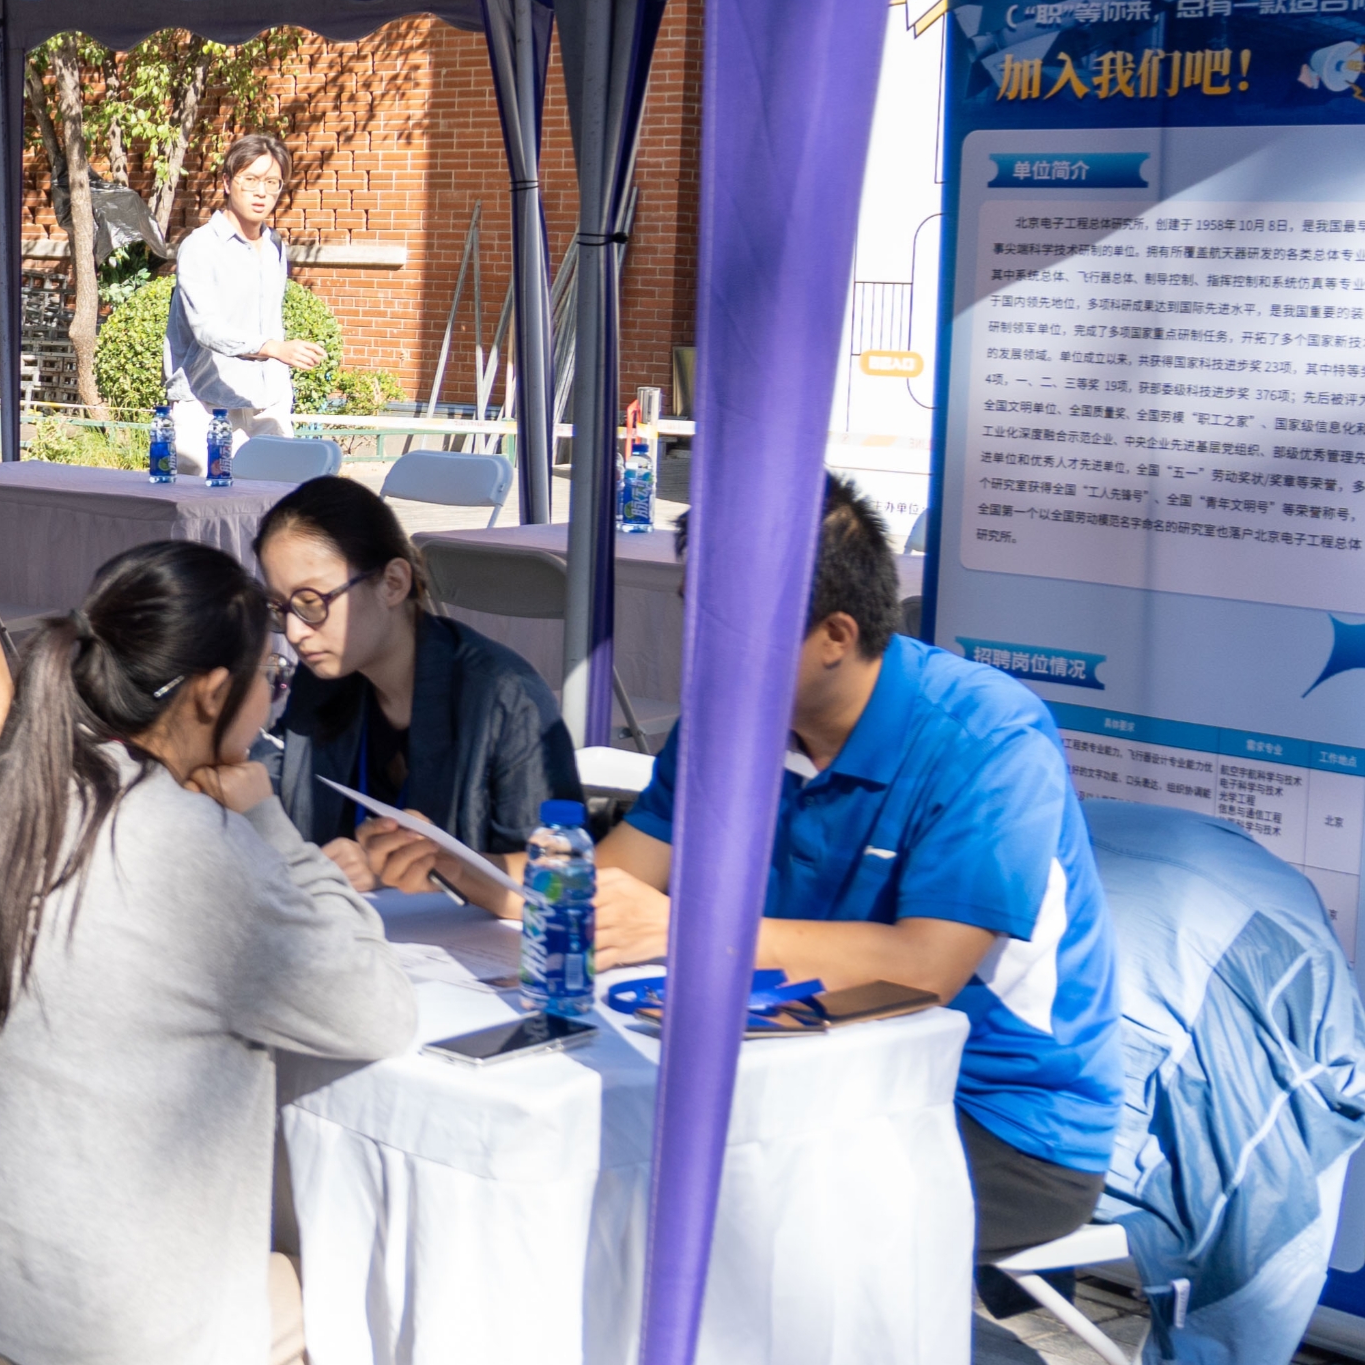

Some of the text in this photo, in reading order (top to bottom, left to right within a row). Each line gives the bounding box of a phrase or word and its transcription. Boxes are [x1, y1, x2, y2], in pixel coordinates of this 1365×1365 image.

[1012, 161, 1090, 181] 单位简介
[1320, 751, 1357, 767] 工作地点
[1325, 815, 1344, 827] 北京
